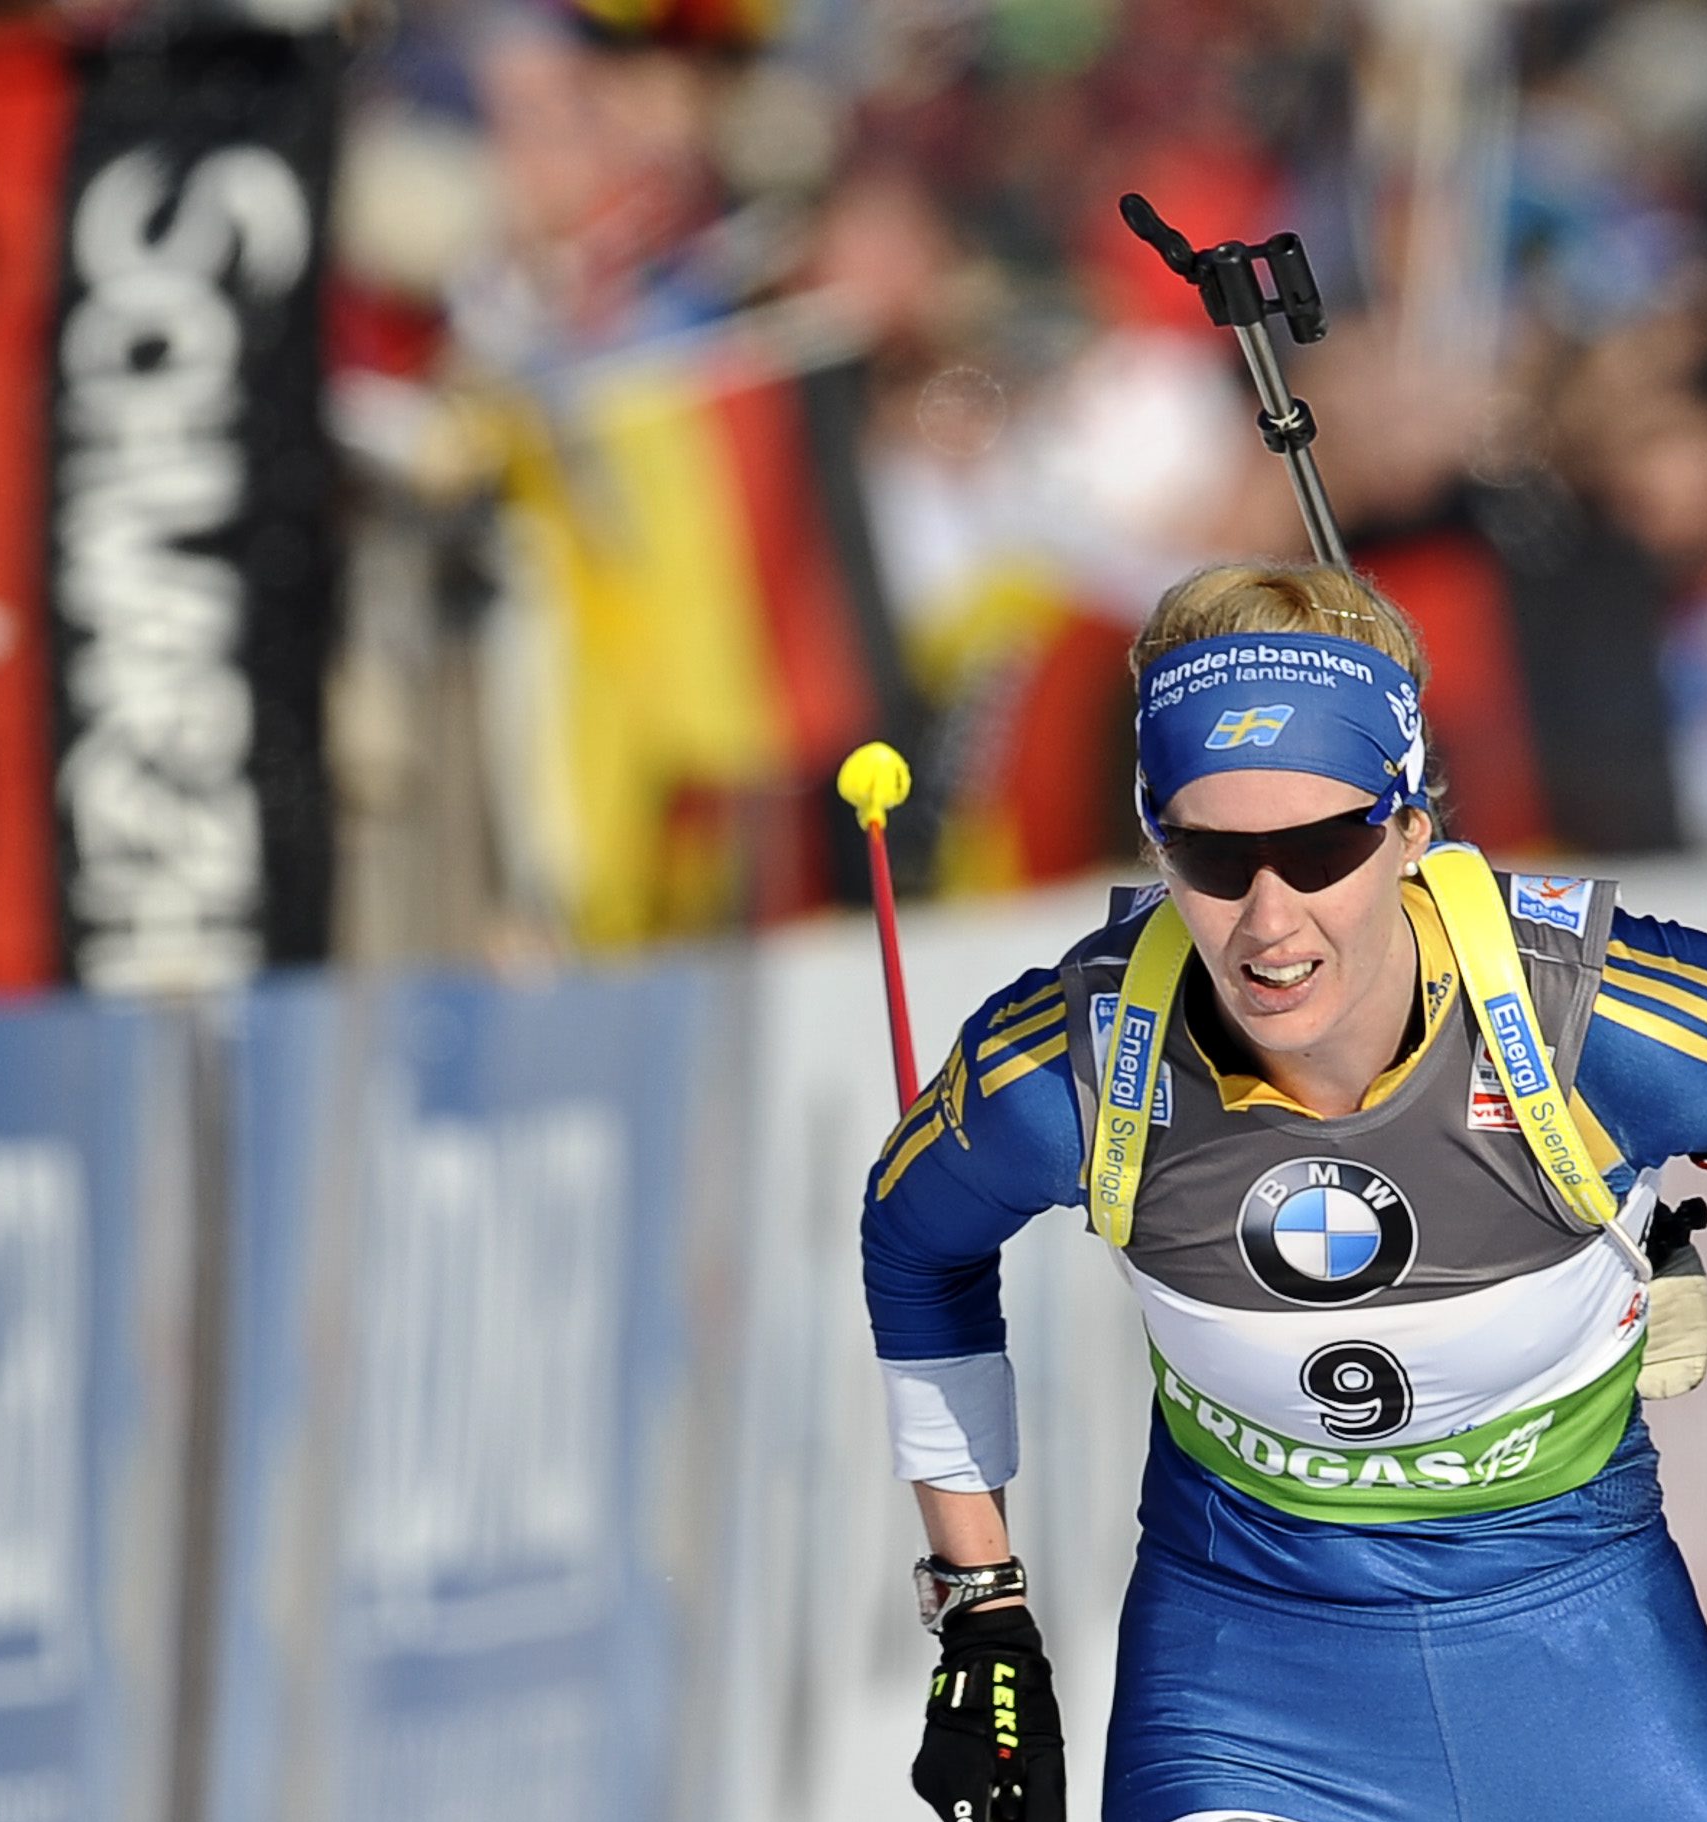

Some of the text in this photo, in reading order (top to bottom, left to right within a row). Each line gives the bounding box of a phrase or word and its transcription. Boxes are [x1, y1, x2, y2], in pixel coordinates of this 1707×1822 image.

[1149, 644, 1374, 698] Handelsbanken
[1187, 667, 1229, 694] och
[1235, 665, 1339, 690] lantbruk
[1100, 1016, 1151, 1206] Energi Sverige
[1493, 1001, 1585, 1187] Energi Sverige
[1257, 1162, 1400, 1211] BMW
[1300, 1339, 1414, 1443] 9
[993, 1661, 1019, 1749] LEKI
